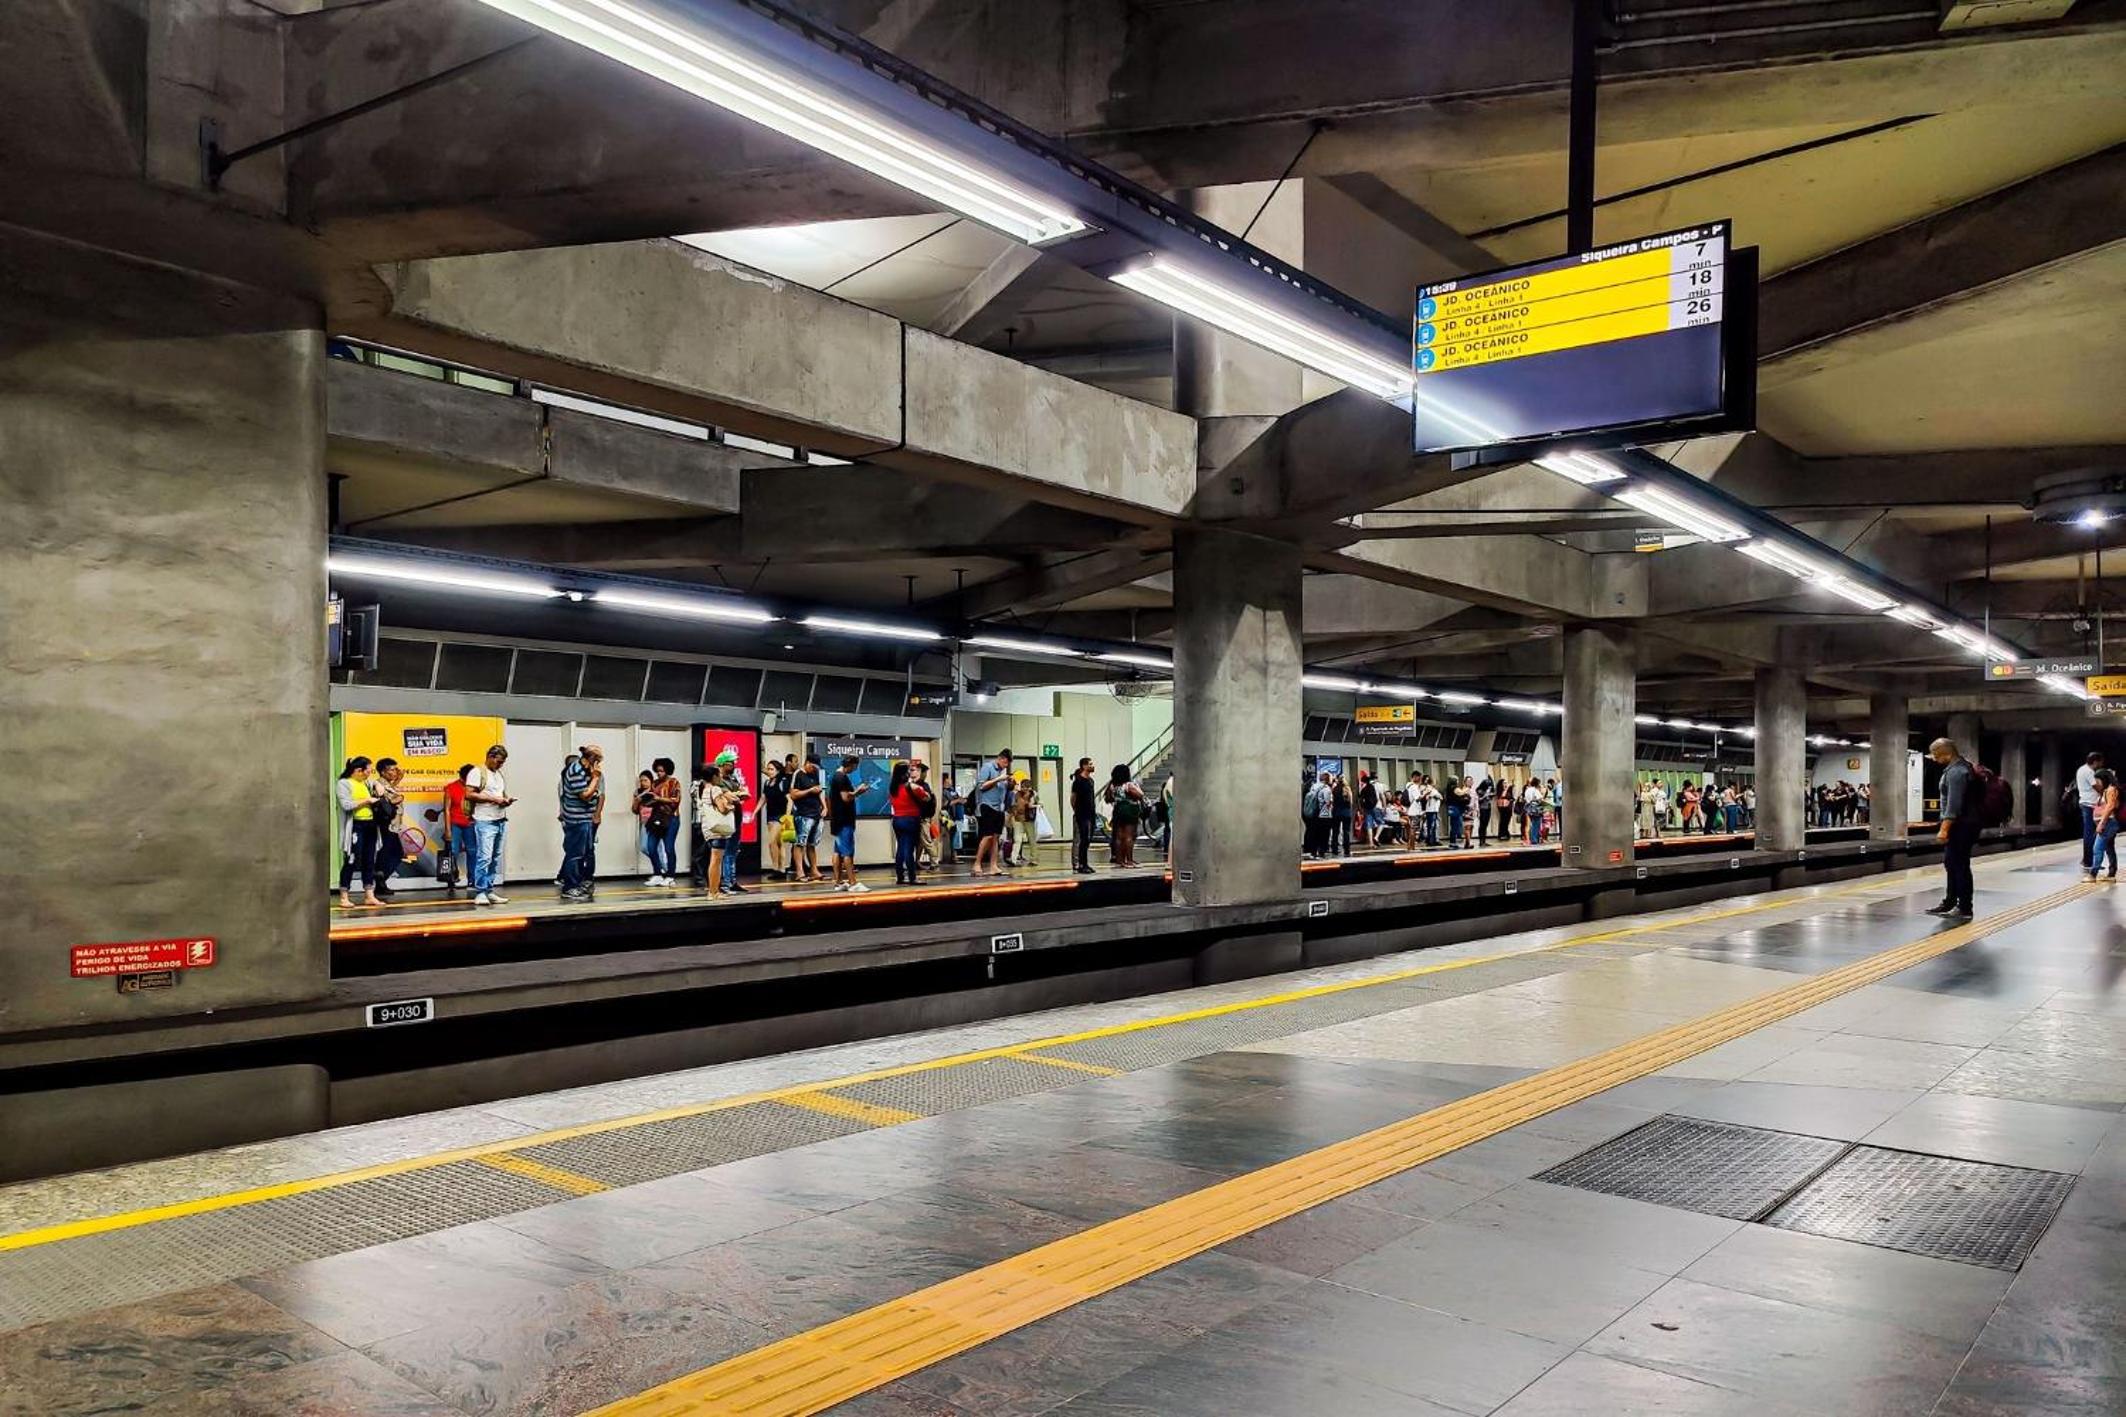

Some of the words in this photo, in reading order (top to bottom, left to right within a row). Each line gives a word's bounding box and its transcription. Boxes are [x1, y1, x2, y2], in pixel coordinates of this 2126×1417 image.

[1581, 243, 1638, 263] Siqueira
[1641, 229, 1699, 250] Campos
[1695, 242, 1707, 256] 7
[1689, 259, 1712, 270] min
[1689, 270, 1712, 286] 18
[1688, 288, 1711, 299] min
[1687, 298, 1712, 315] 26
[1687, 317, 1710, 327] min
[827, 743, 864, 757] Siqueira
[867, 745, 900, 759] Campos
[98, 945, 151, 956] ATRAVESSE
[75, 957, 111, 966] PERIGO
[128, 954, 149, 962] VIDA
[75, 965, 116, 975] TRILHOS
[118, 960, 182, 971] ENERGIZADOS
[381, 1005, 421, 1022] 9+030
